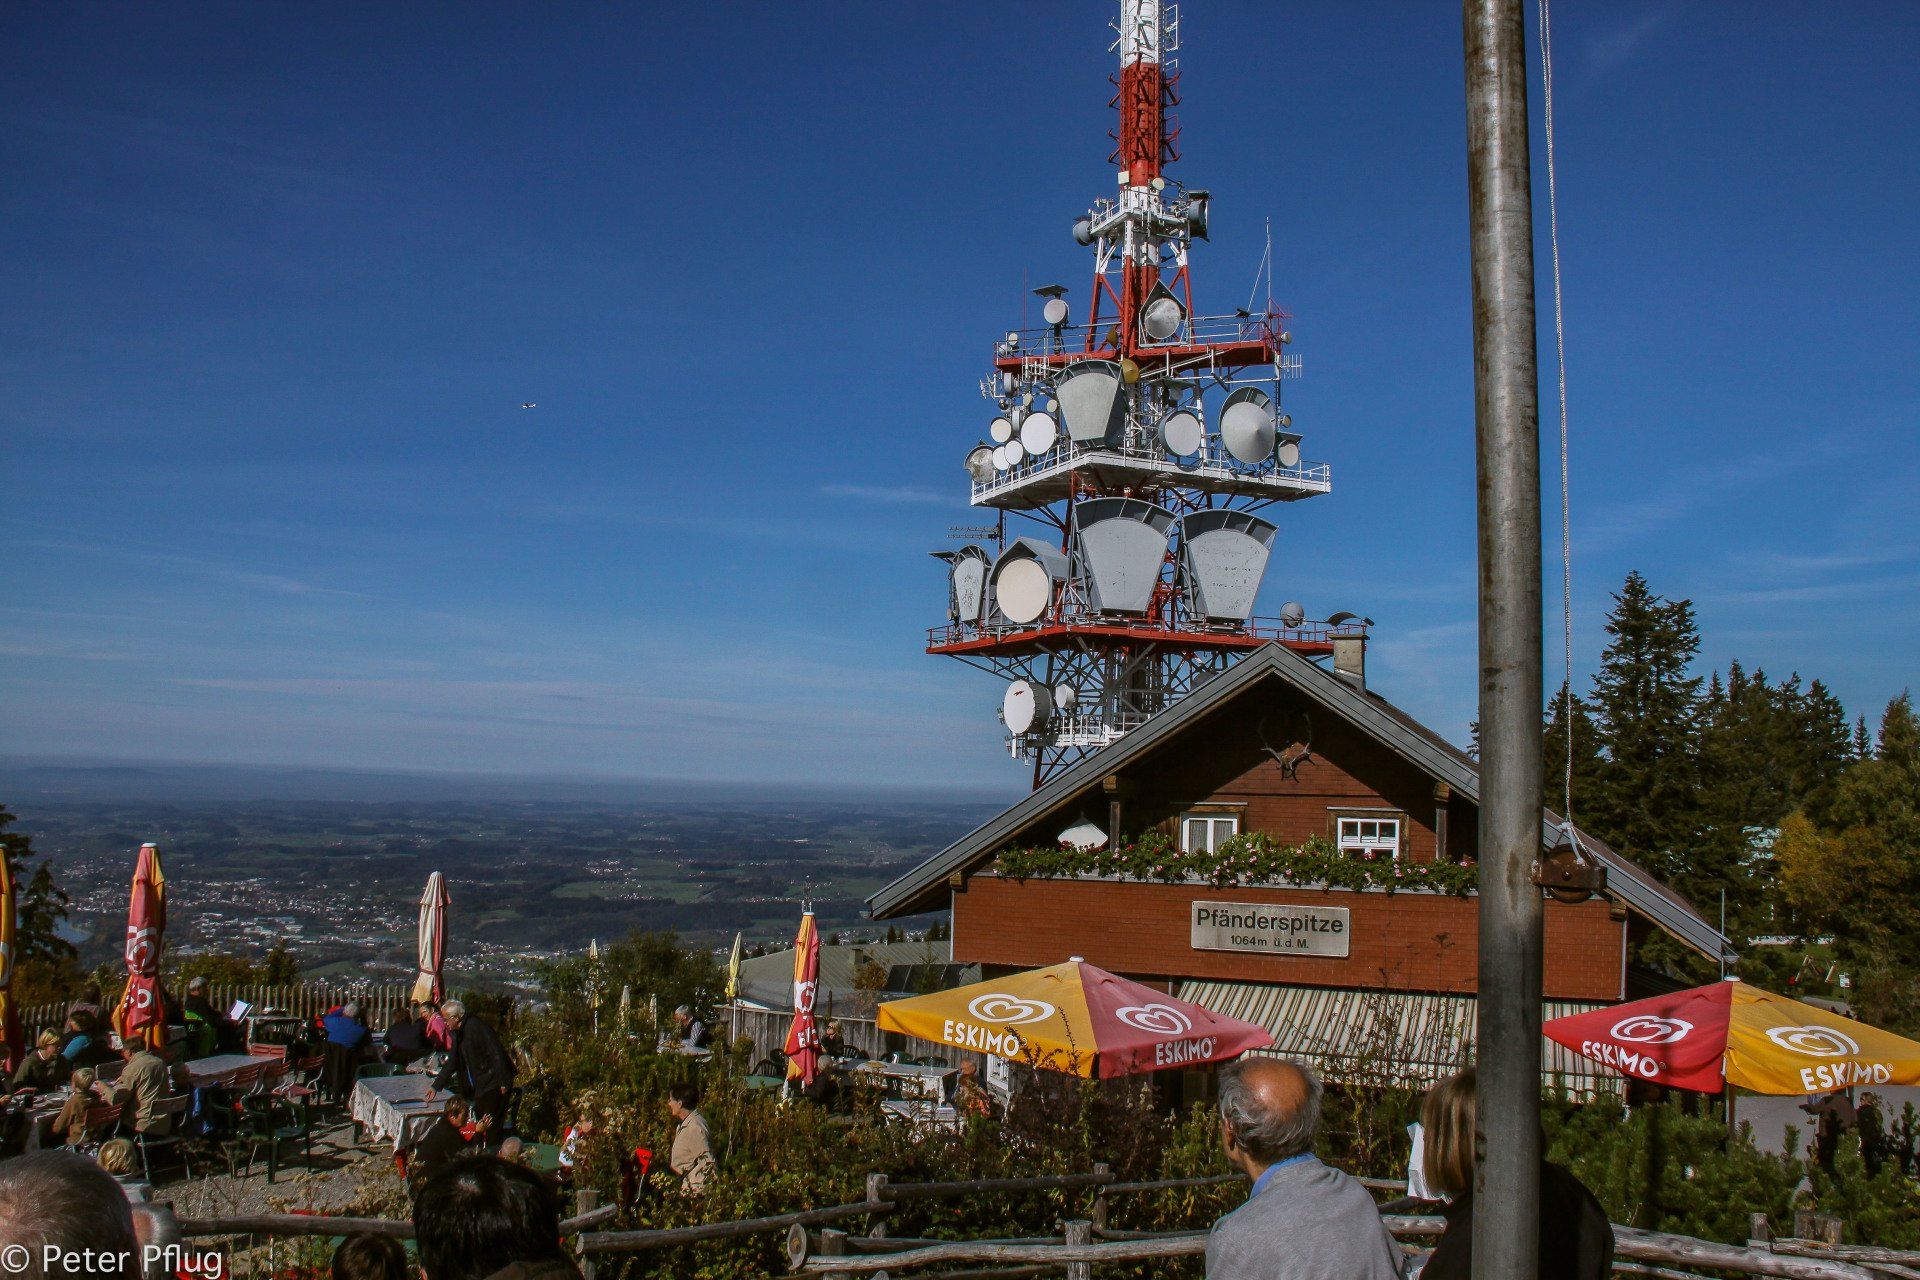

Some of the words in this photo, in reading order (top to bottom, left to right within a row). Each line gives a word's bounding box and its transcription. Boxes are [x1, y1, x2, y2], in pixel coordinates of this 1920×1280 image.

[1197, 908, 1344, 935] Pfänderspitze
[943, 1019, 1021, 1057] ESKIMO
[1155, 1037, 1213, 1066] ESKIMO
[1582, 1040, 1660, 1078] ESKIMO
[1800, 1061, 1890, 1091] ESKIMO
